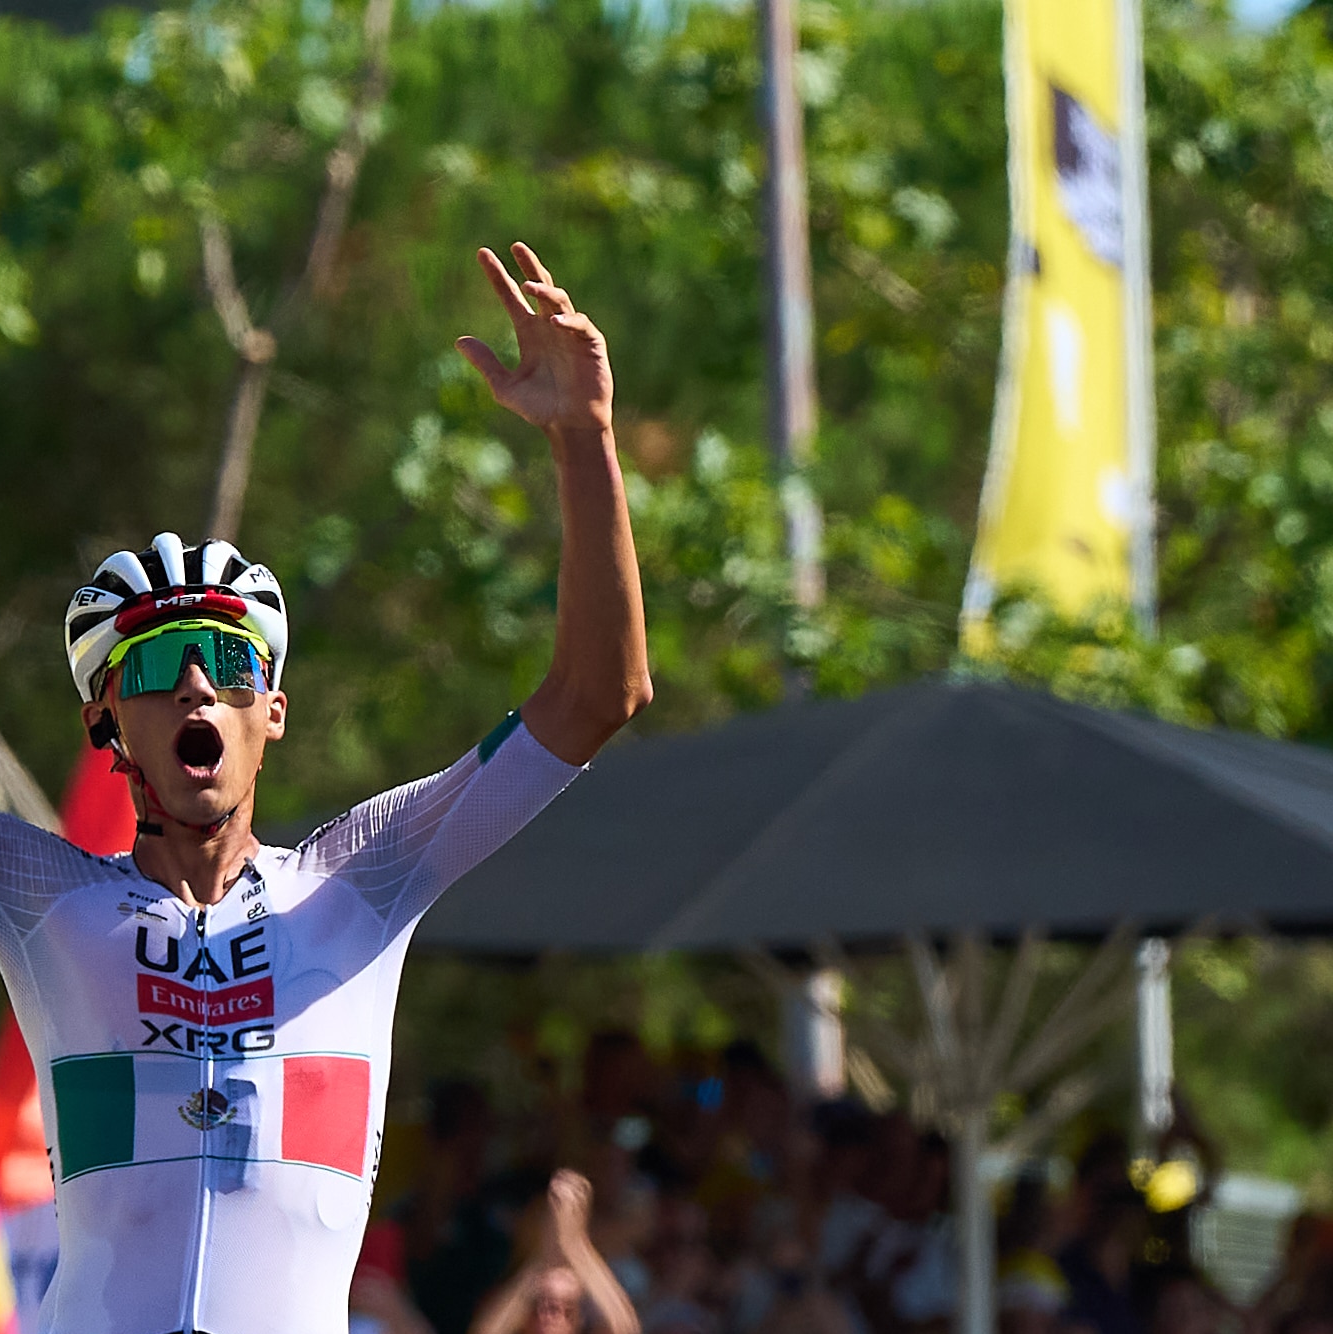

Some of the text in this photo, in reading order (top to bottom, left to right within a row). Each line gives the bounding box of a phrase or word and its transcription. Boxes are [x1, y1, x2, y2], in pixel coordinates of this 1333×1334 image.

[155, 593, 207, 609] MET
[135, 925, 270, 985] UAE
[151, 985, 262, 1018] Emirates
[139, 1019, 275, 1055] XRG
